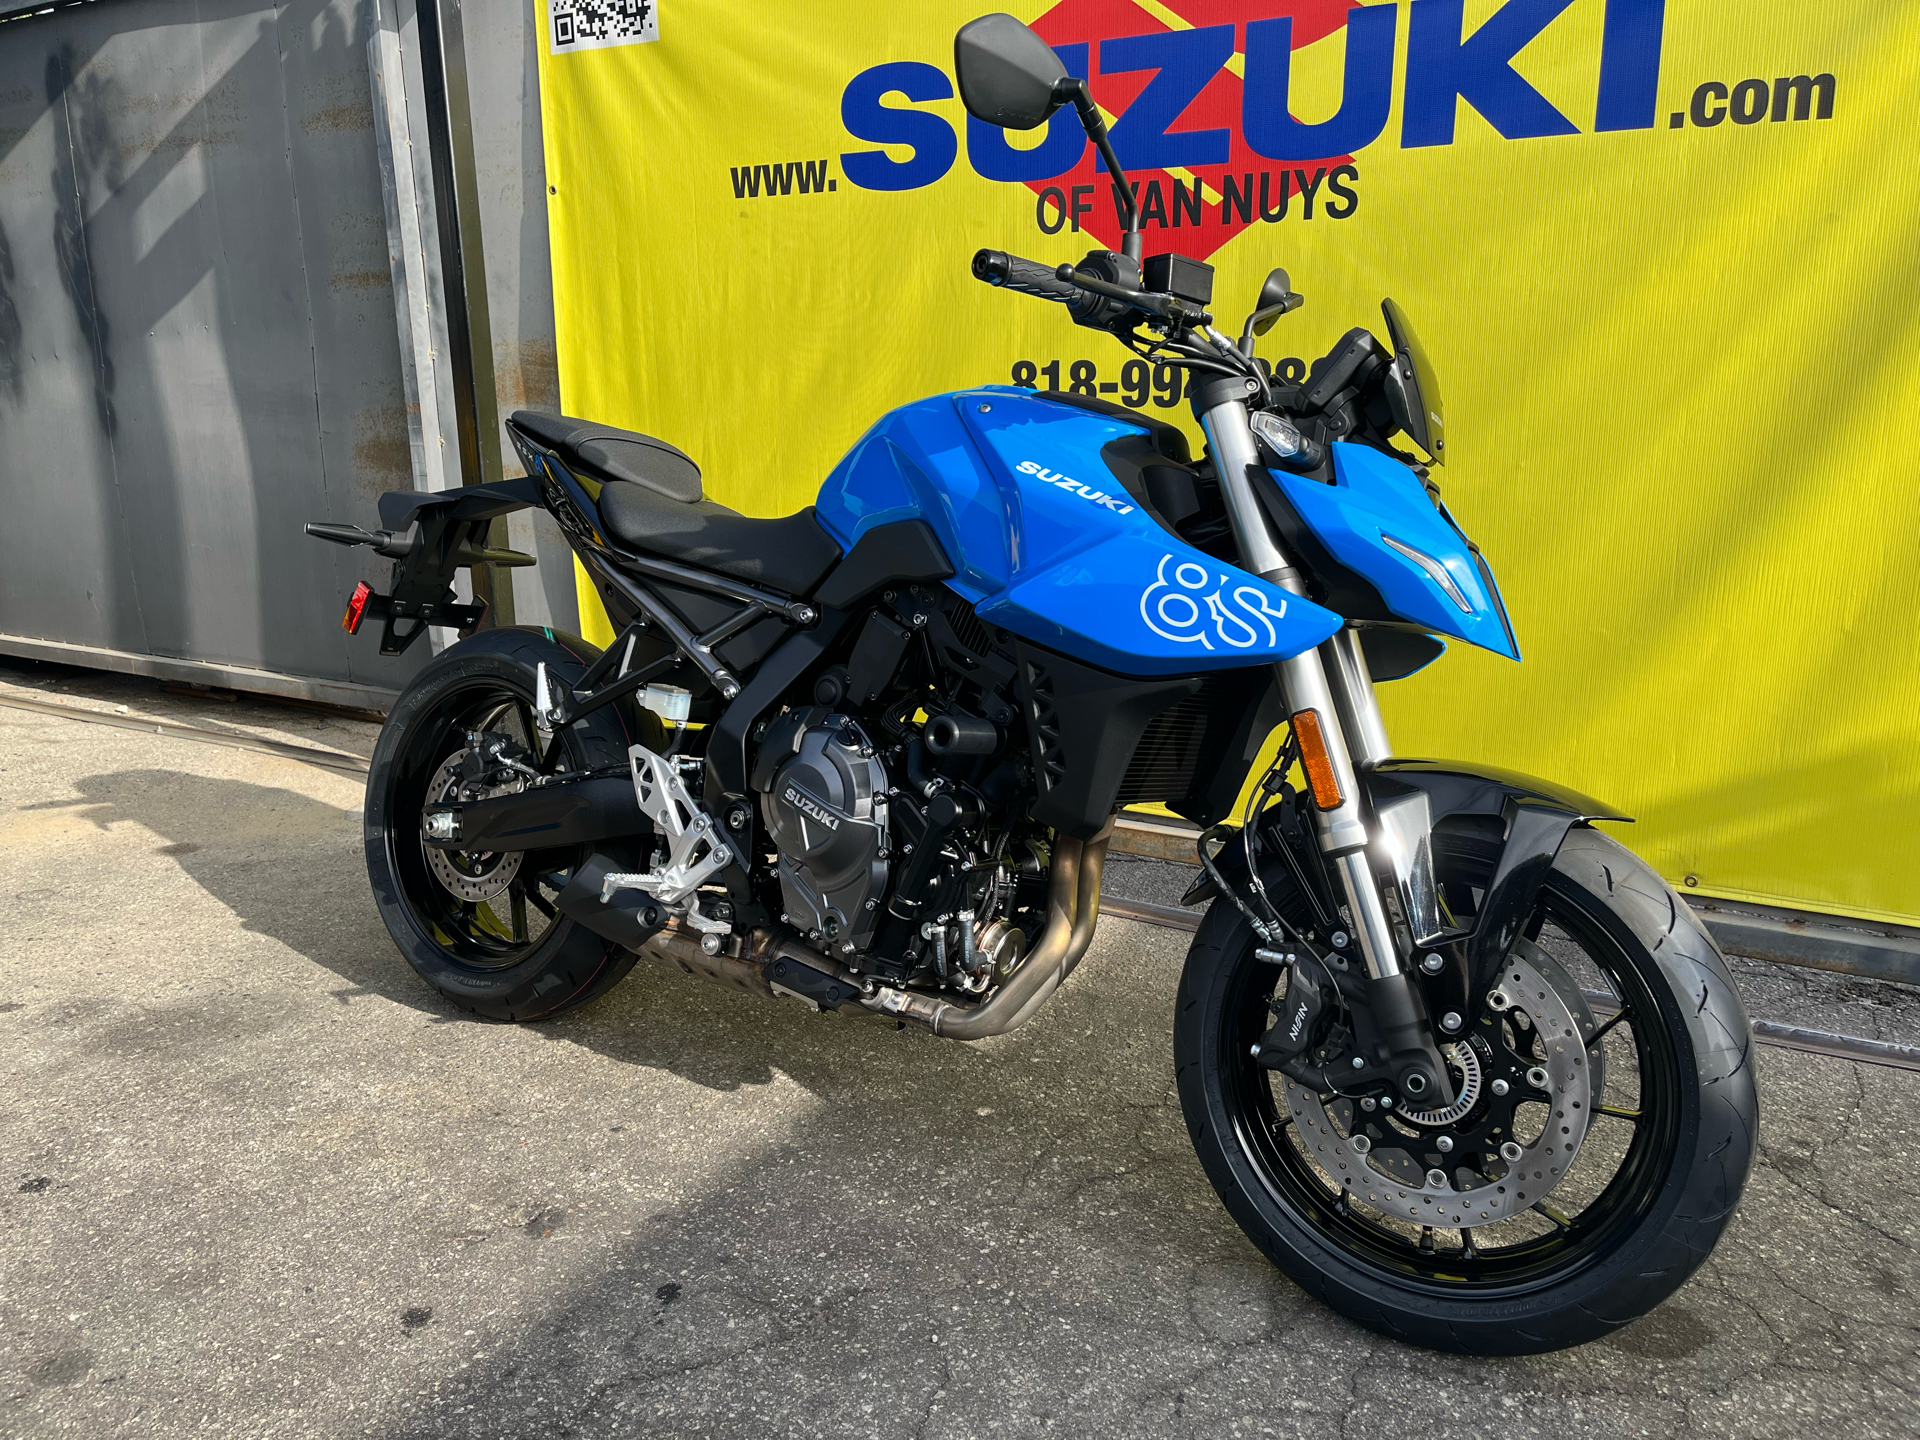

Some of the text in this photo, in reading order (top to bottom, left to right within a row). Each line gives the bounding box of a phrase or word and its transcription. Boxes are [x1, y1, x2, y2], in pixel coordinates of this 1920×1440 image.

[730, 159, 837, 199] www.
[1669, 73, 1836, 129] .com
[1036, 165, 1359, 235] OF VAN NUYS
[1015, 460, 1135, 515] SUZUKI
[784, 787, 840, 831] SUZUKI
